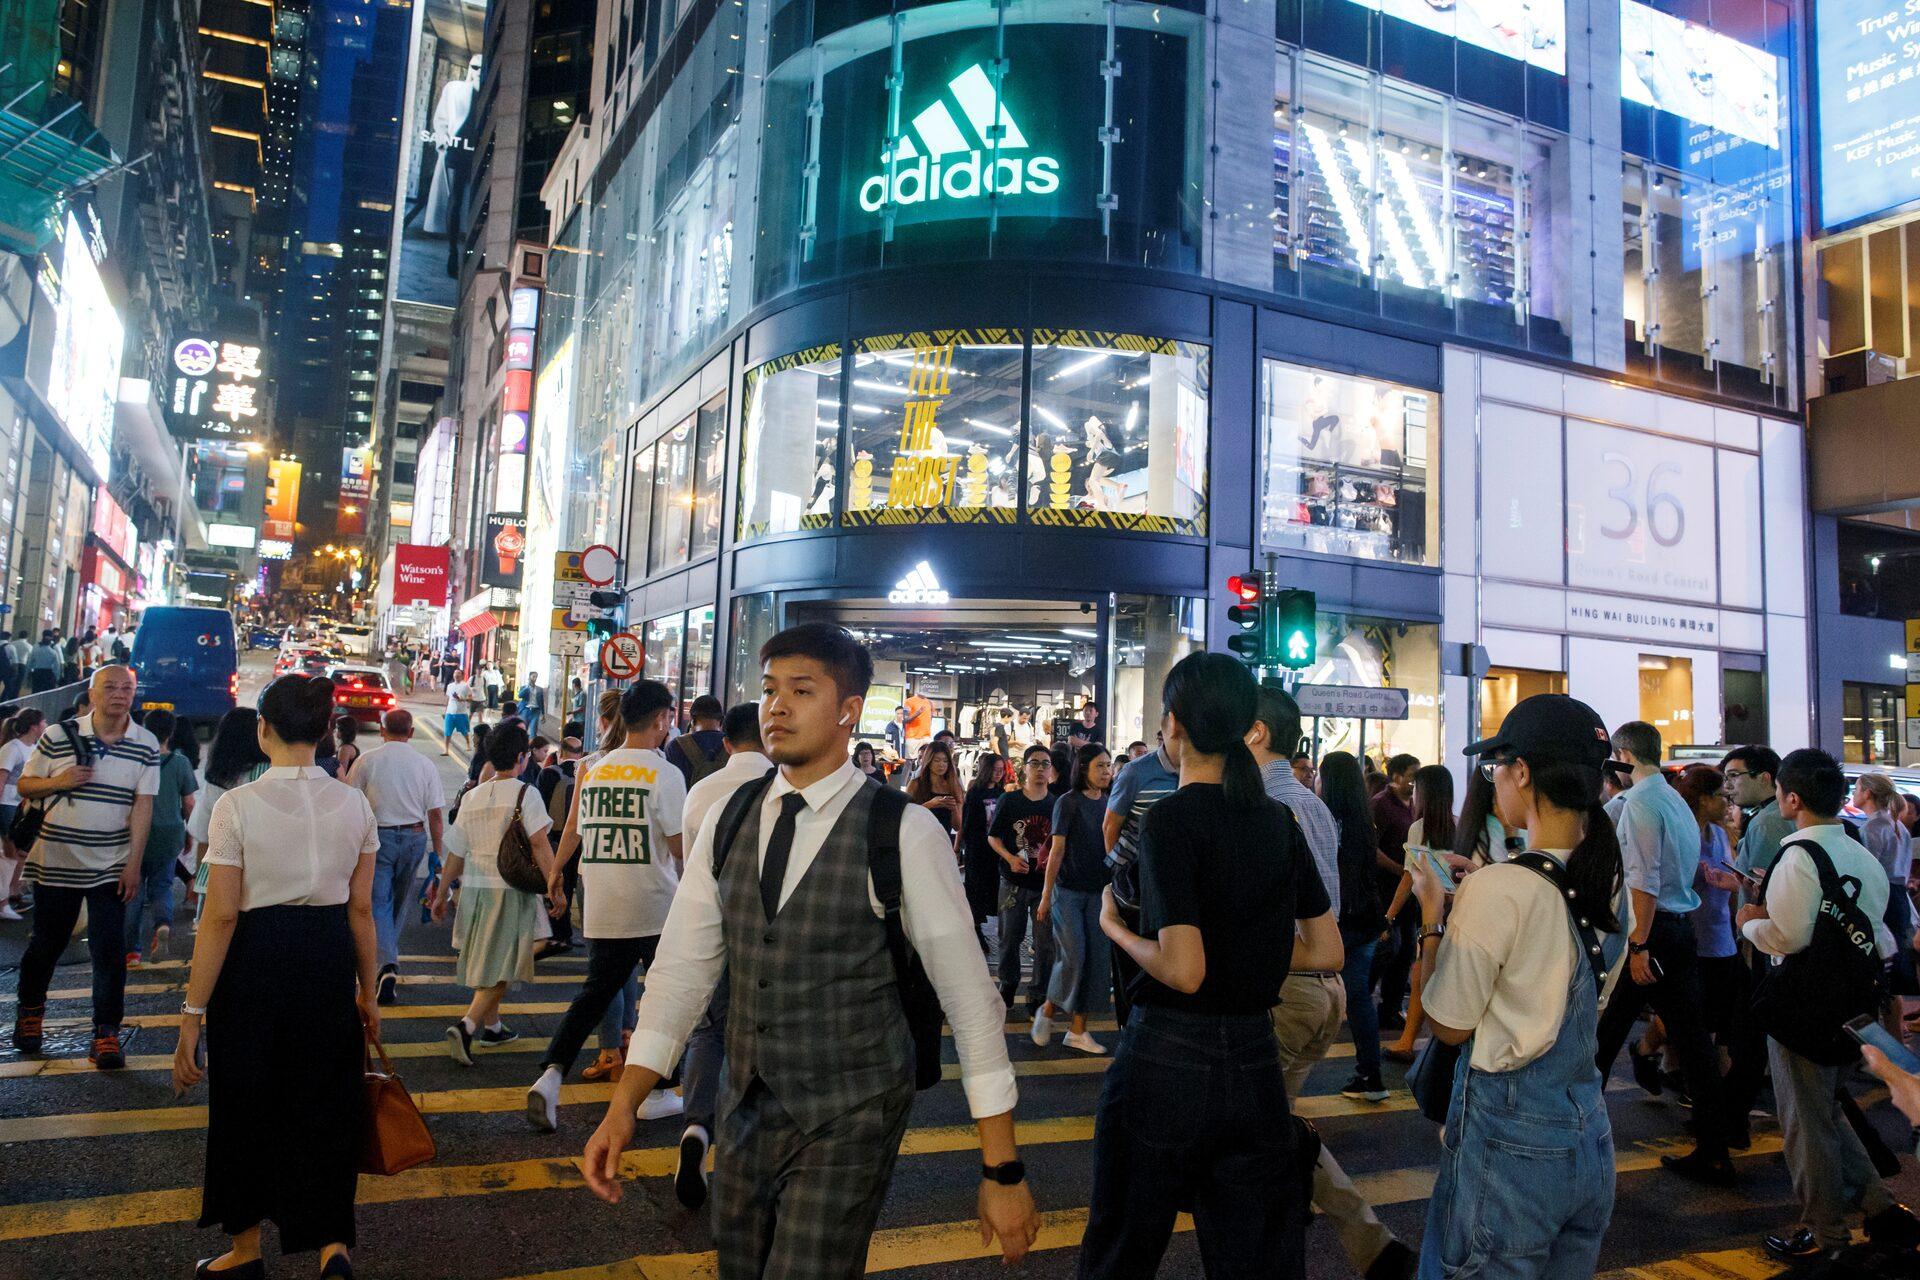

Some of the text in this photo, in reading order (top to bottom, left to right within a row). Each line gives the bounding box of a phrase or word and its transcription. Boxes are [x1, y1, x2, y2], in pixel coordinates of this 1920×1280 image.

[1857, 12, 1898, 36] True
[1847, 52, 1897, 81] Music
[1846, 130, 1917, 163] KEF Music
[859, 150, 1060, 212] adidas
[907, 345, 955, 396] FEEL
[900, 400, 943, 451] THE
[887, 456, 962, 508] BOOST
[1600, 451, 1686, 548] 36
[400, 564, 444, 575] Watson's
[400, 573, 425, 584] Wine
[888, 588, 950, 604] adidas
[1571, 606, 1599, 619] HING
[1603, 610, 1622, 622] WAI
[1626, 613, 1676, 629] BUILDING
[1312, 688, 1341, 698] Queen's
[1342, 690, 1363, 699] Road
[1324, 702, 1379, 715] 皇后大道中
[581, 786, 651, 819] STREET
[582, 826, 645, 862] WEAR
